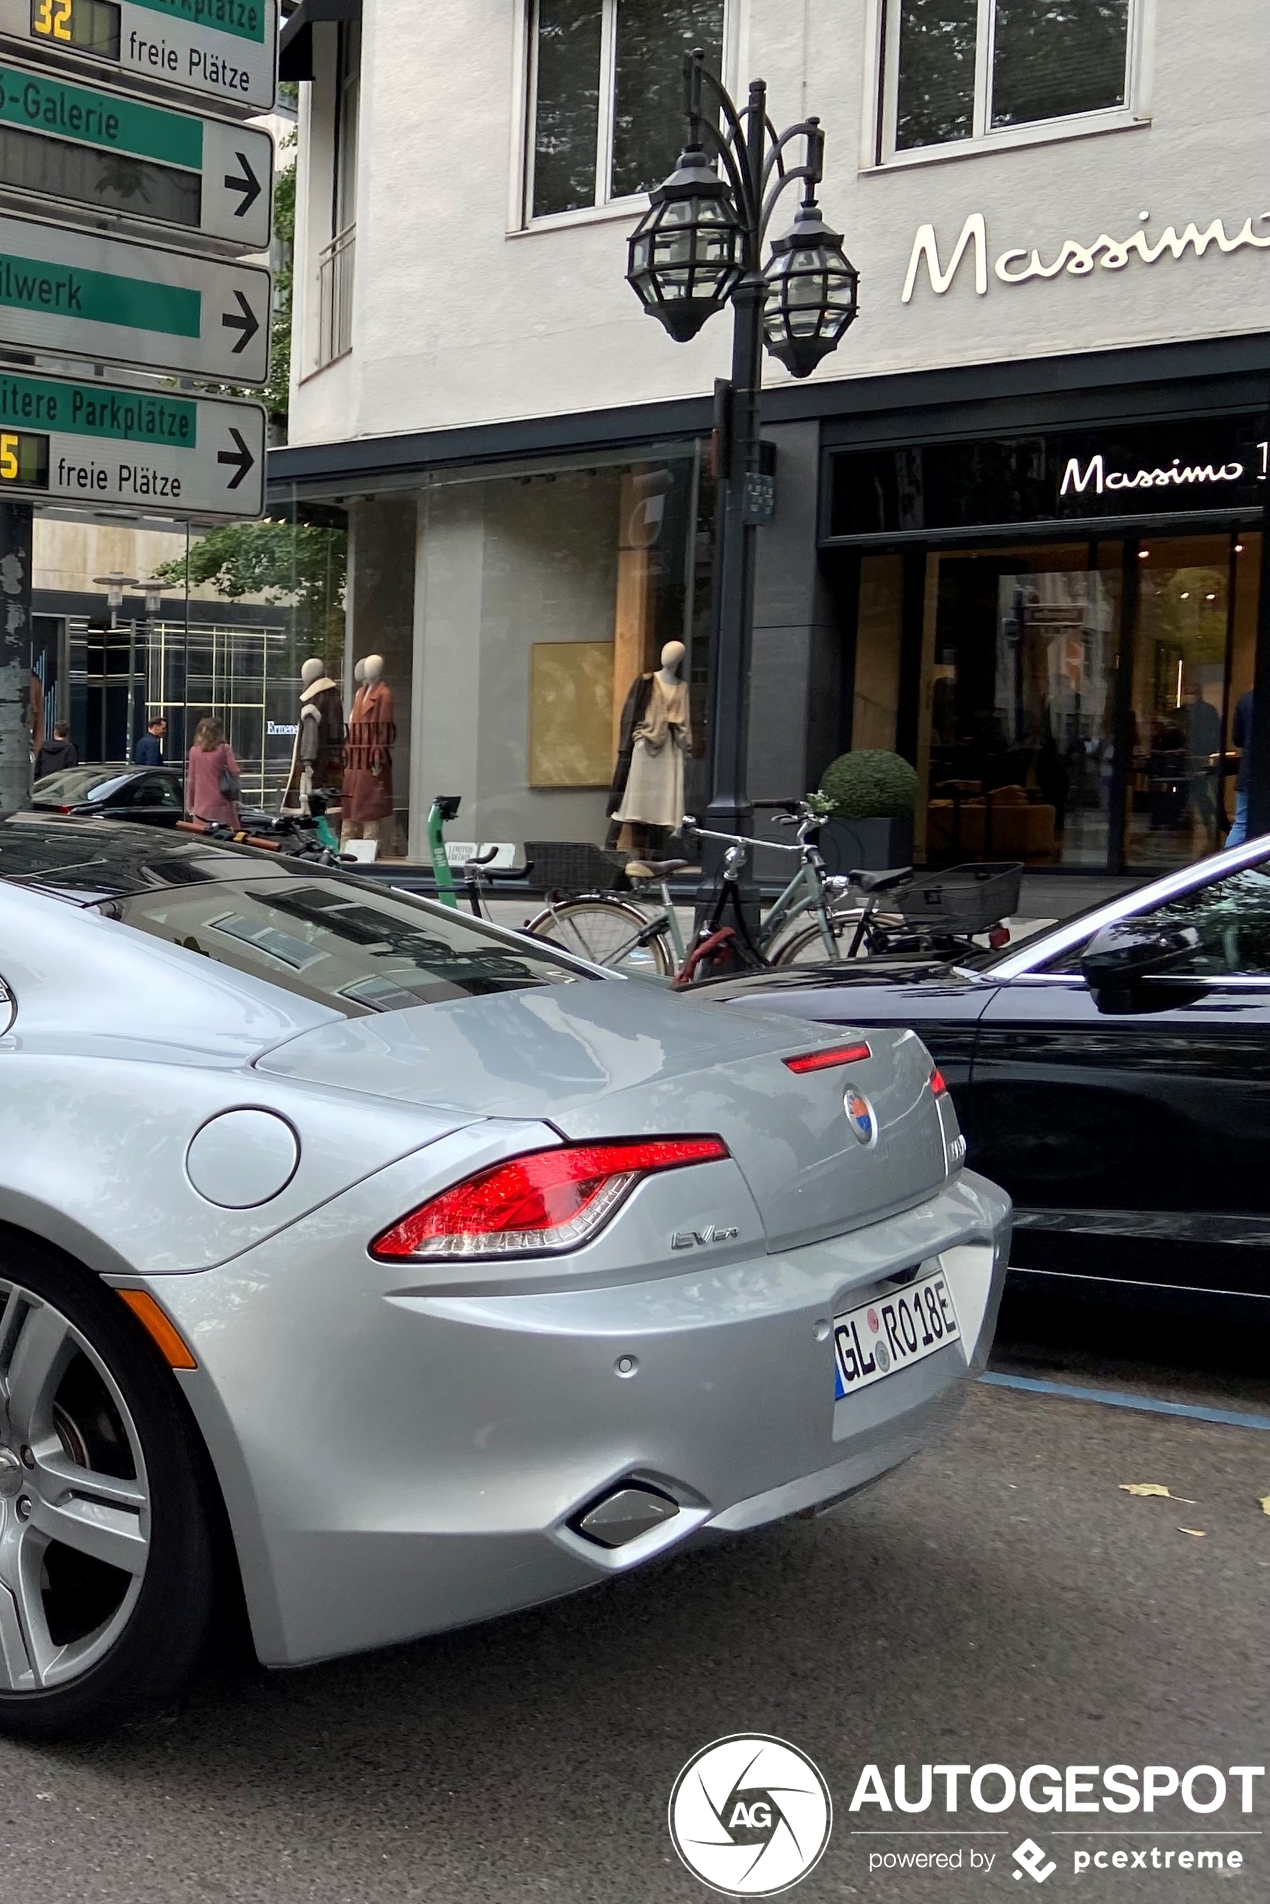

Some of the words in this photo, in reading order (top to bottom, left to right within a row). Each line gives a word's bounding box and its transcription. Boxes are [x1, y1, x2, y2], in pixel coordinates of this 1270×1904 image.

[34, 0, 71, 41] 32
[131, 31, 178, 71] freie
[189, 48, 250, 92] Plätze
[72, 389, 190, 440] Parkplätze
[58, 457, 108, 490] freie
[119, 464, 182, 498] Plätze
[1060, 454, 1244, 496] Massimo
[834, 1320, 876, 1381] GL
